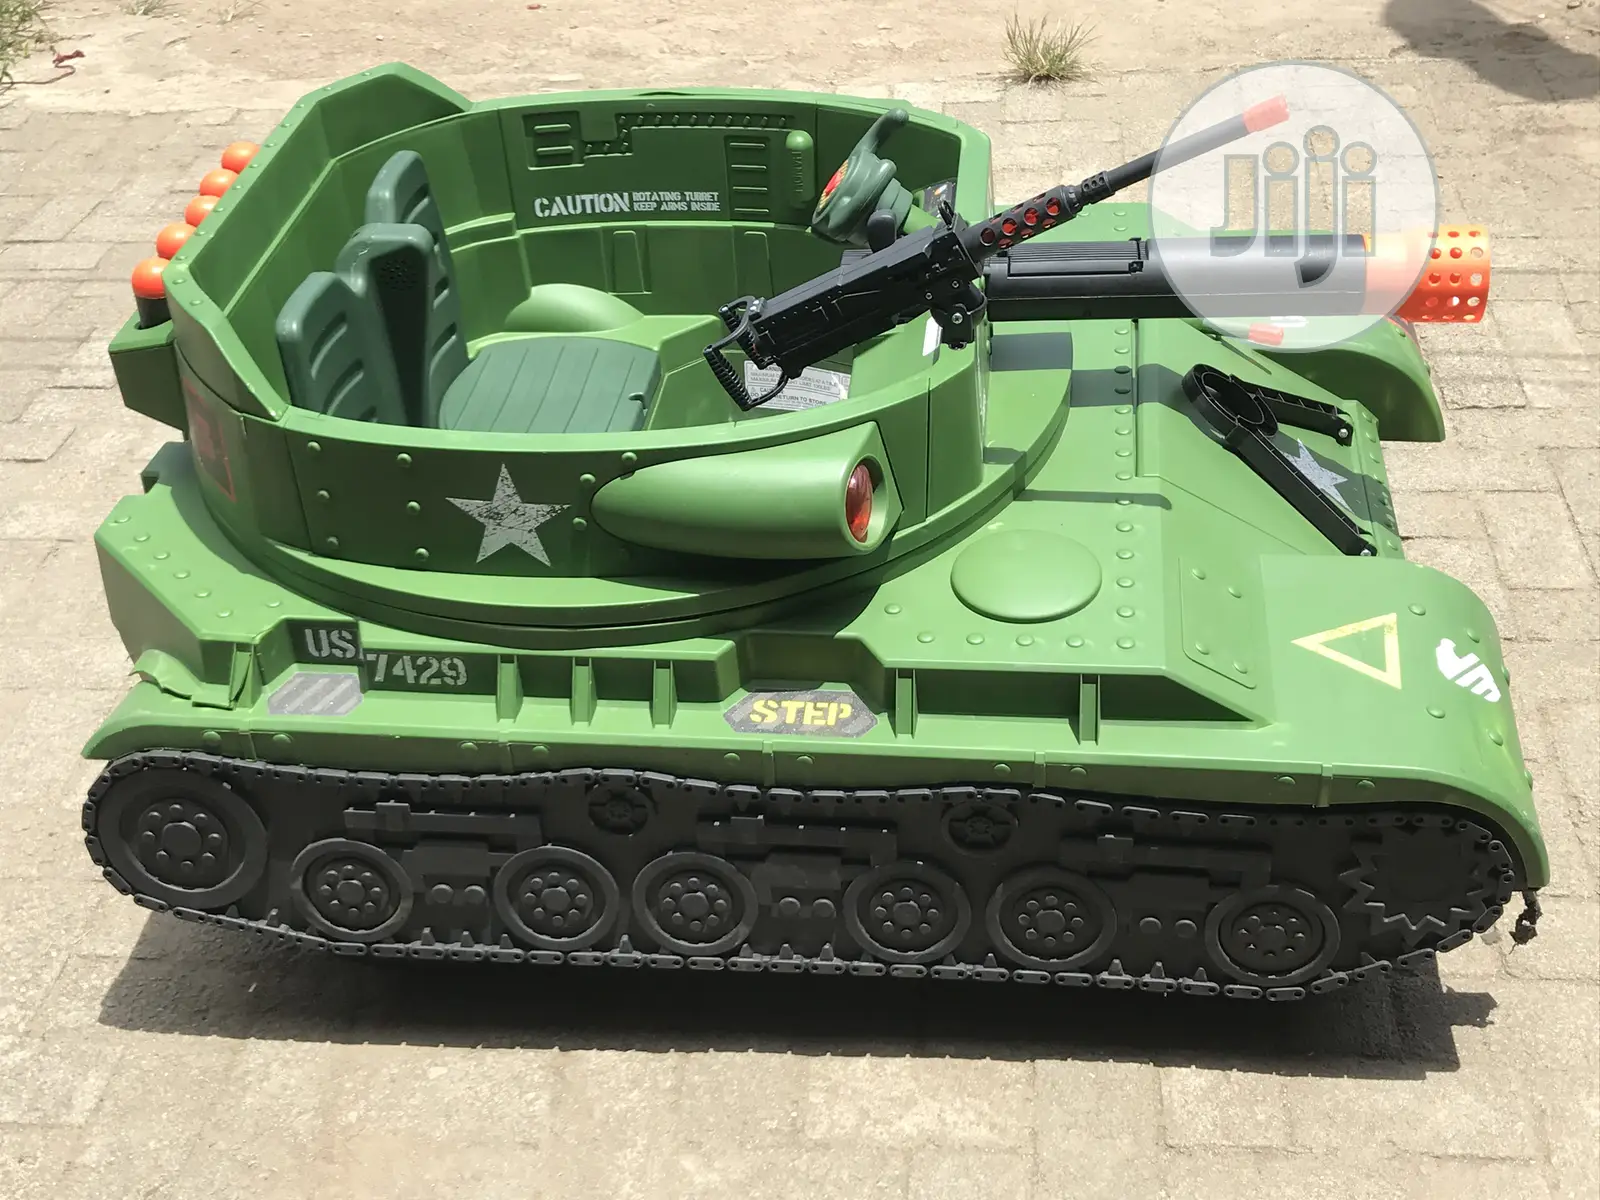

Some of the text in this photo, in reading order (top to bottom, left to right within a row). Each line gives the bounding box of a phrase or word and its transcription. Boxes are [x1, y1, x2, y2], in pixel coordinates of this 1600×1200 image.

[534, 192, 631, 218] CAUTION
[632, 191, 720, 202] ROTATING TURRET
[633, 202, 721, 212] KEEP ARMS INSIDE
[304, 628, 356, 658] US
[359, 648, 468, 686] 7429
[749, 699, 853, 726] STEP
